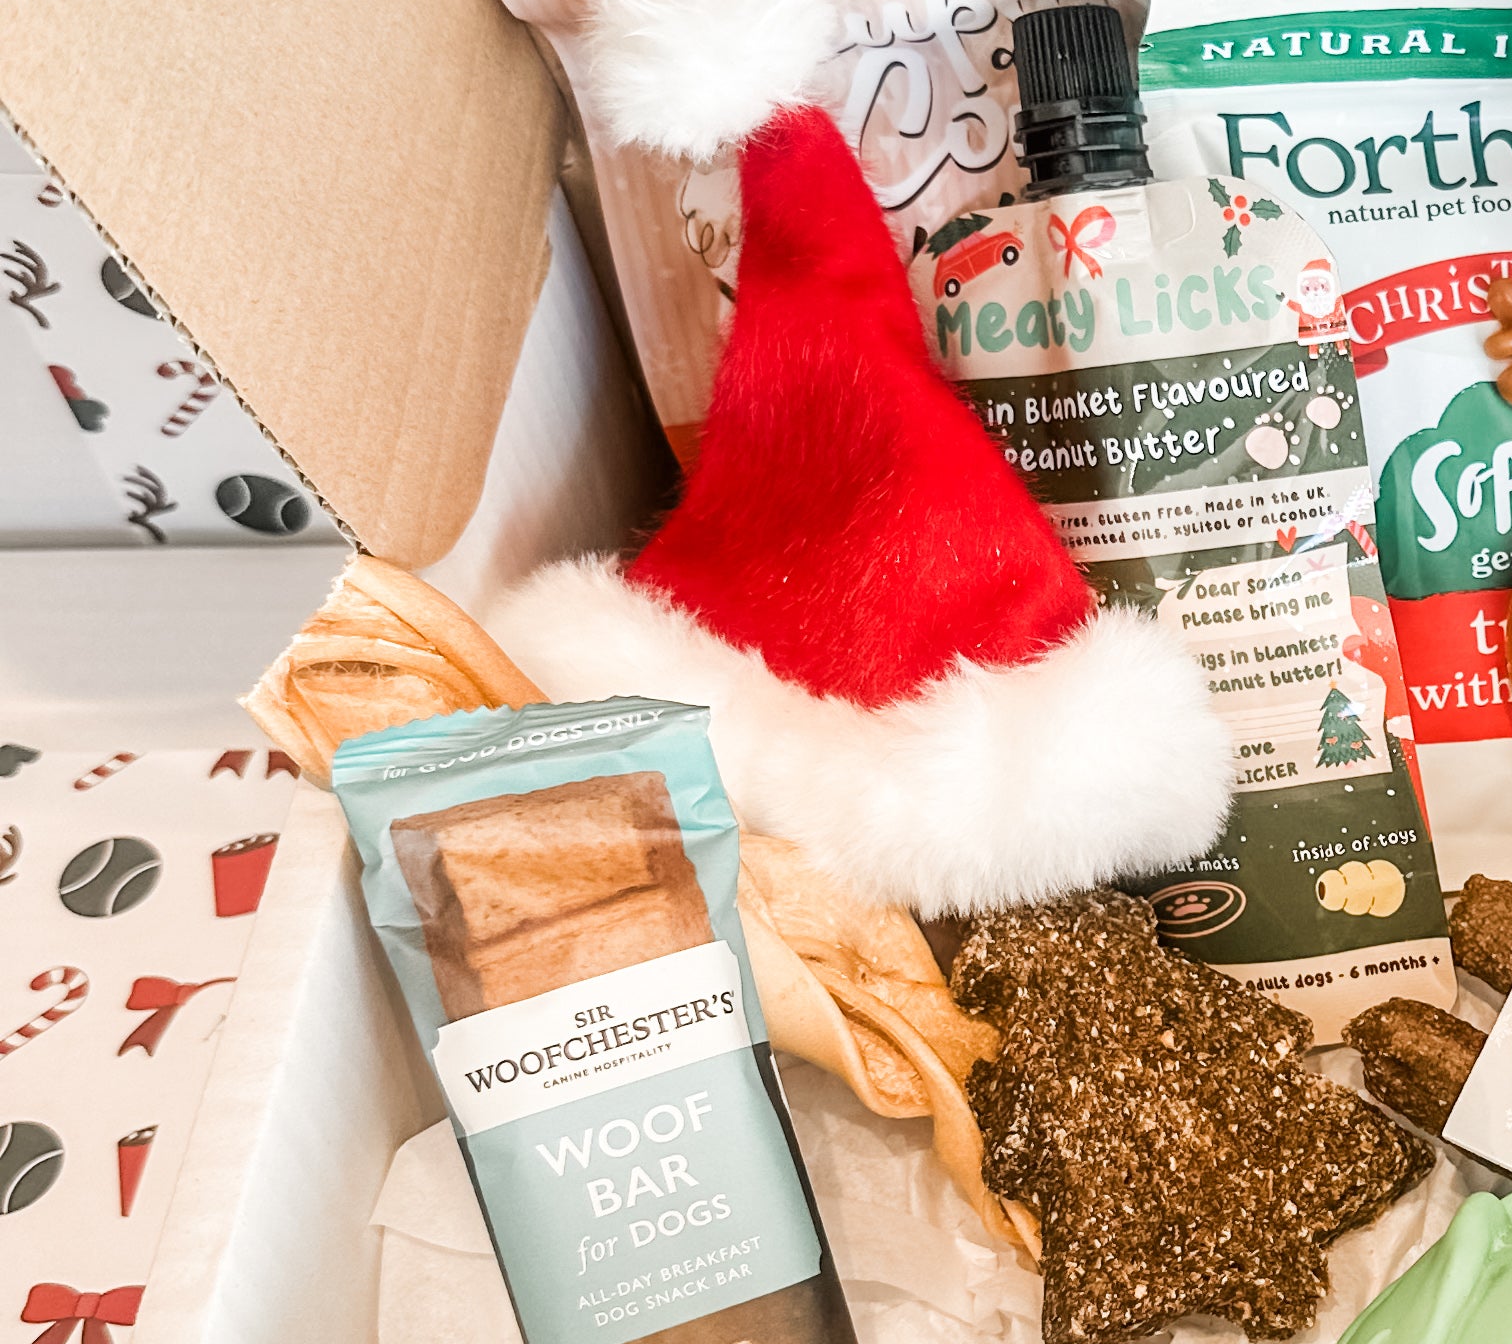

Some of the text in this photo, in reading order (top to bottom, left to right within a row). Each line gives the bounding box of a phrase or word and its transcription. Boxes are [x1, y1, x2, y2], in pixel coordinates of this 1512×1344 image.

[1202, 29, 1466, 61] NATURAL
[1328, 199, 1419, 225] natural
[1426, 197, 1467, 222] pet
[935, 287, 1096, 357] Meaty
[987, 360, 1310, 427] in Blanket Flavoured
[1098, 507, 1152, 526] Gluten
[1204, 497, 1244, 513] Made
[1250, 495, 1265, 507] in
[1271, 491, 1300, 505] the
[1173, 518, 1232, 537] xylitol
[1237, 516, 1254, 529] or
[1195, 580, 1241, 600] Dear
[1181, 591, 1334, 630] Please bring me
[1230, 649, 1250, 666] in
[1252, 633, 1339, 663] blankets
[1207, 658, 1343, 694] eanut butter!
[381, 765, 411, 781] for
[506, 724, 584, 752] DOGS
[592, 708, 666, 735] ONLY
[1199, 856, 1240, 872] mats
[1292, 828, 1418, 864] Inside of toys
[1294, 971, 1334, 988] dogs
[1349, 965, 1360, 979] 6
[1364, 954, 1428, 977] months
[574, 1004, 616, 1029] SIR
[542, 1042, 673, 1090] CANINE HOSPITALITY
[535, 1090, 714, 1178] WOOF
[585, 1153, 701, 1219] BAR
[577, 1193, 733, 1277] for DOGS
[577, 1235, 762, 1311] ALL-DAY BREAKFAST
[594, 1262, 754, 1328] DOG SNACK BAR
